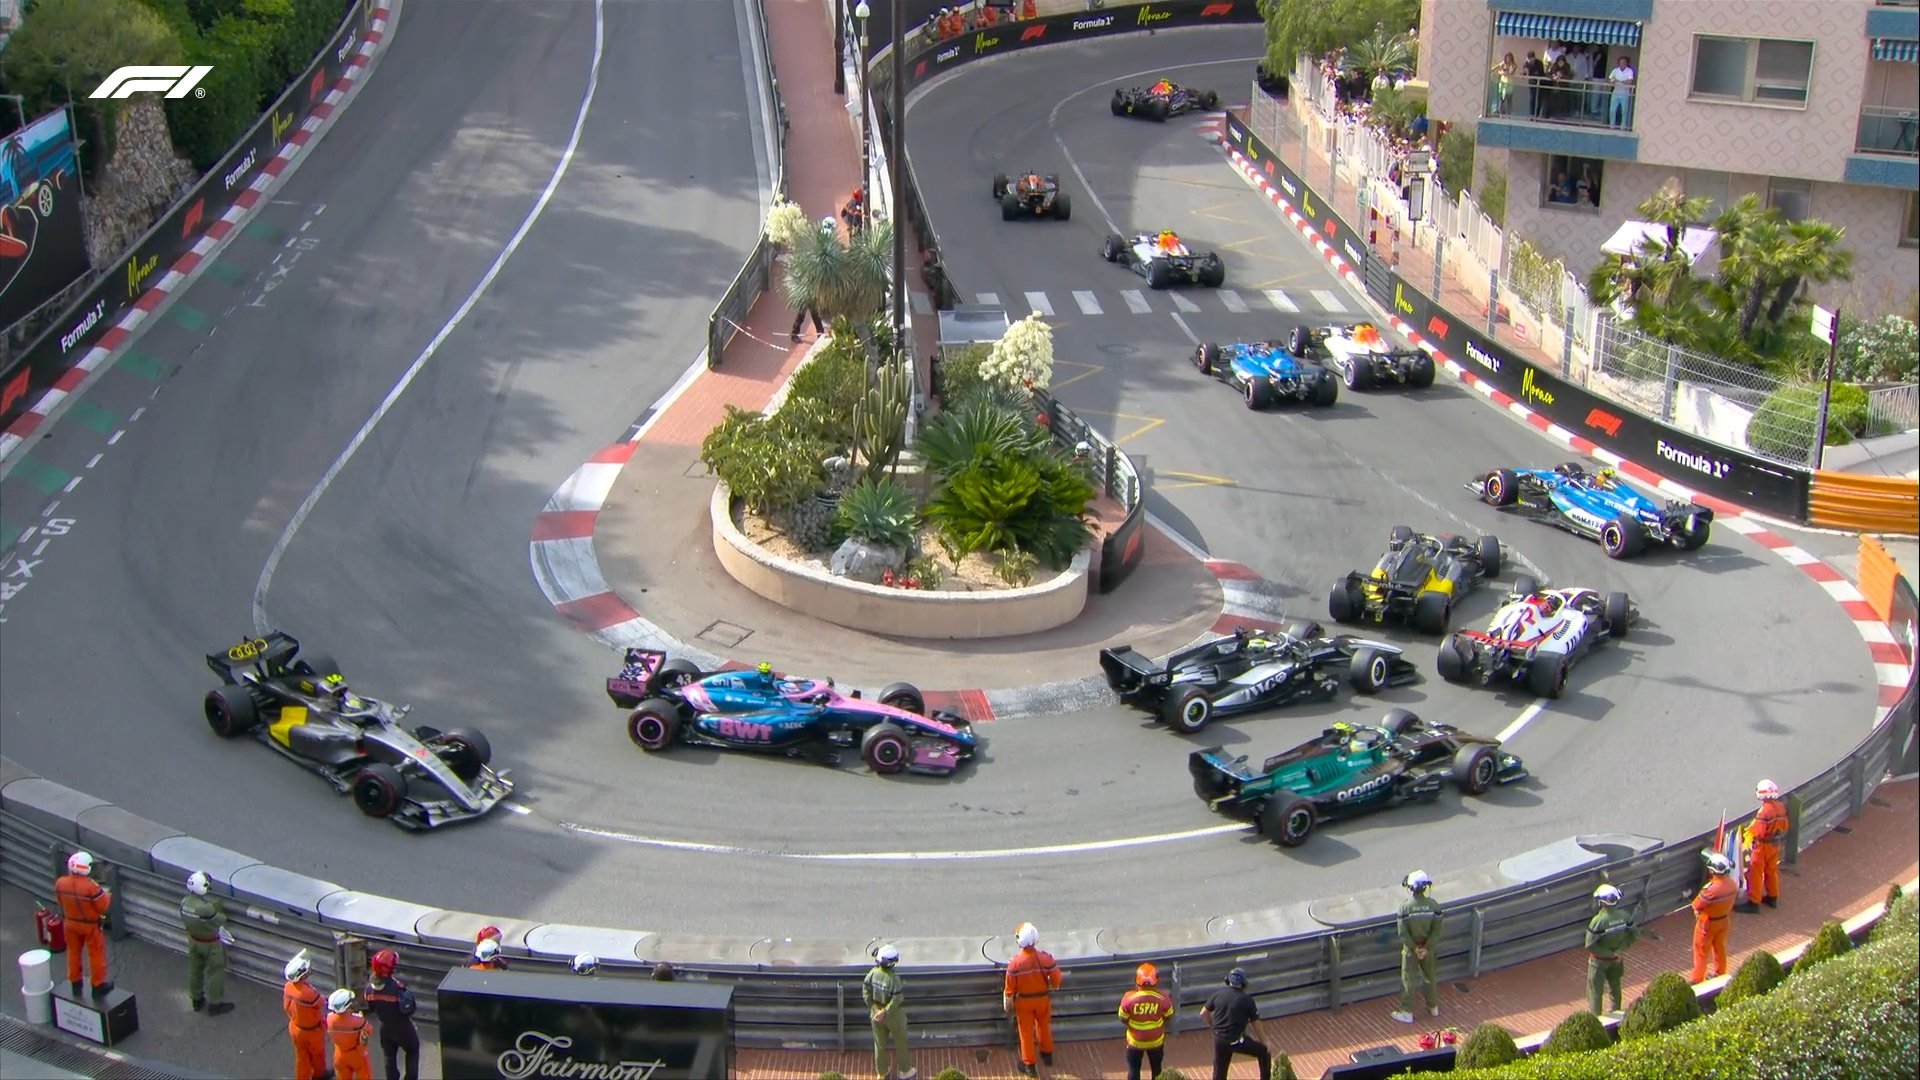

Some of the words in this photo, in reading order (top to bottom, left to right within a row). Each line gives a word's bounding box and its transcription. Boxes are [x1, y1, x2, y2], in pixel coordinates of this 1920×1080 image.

[1073, 18, 1105, 30] Formula
[1137, 5, 1172, 26] Monaco
[975, 32, 1000, 54] Monaco
[225, 156, 251, 190] Formula
[128, 254, 159, 297] Monaco
[61, 311, 98, 353] Formula
[1465, 341, 1493, 370] Formula
[1522, 368, 1554, 404] Monaco
[1656, 439, 1712, 475] Formula
[676, 673, 692, 686] 43
[719, 718, 773, 742] BWT
[1337, 774, 1391, 801] aramco
[1133, 1002, 1160, 1017] CSPM
[496, 1031, 666, 1080] Fairmont
